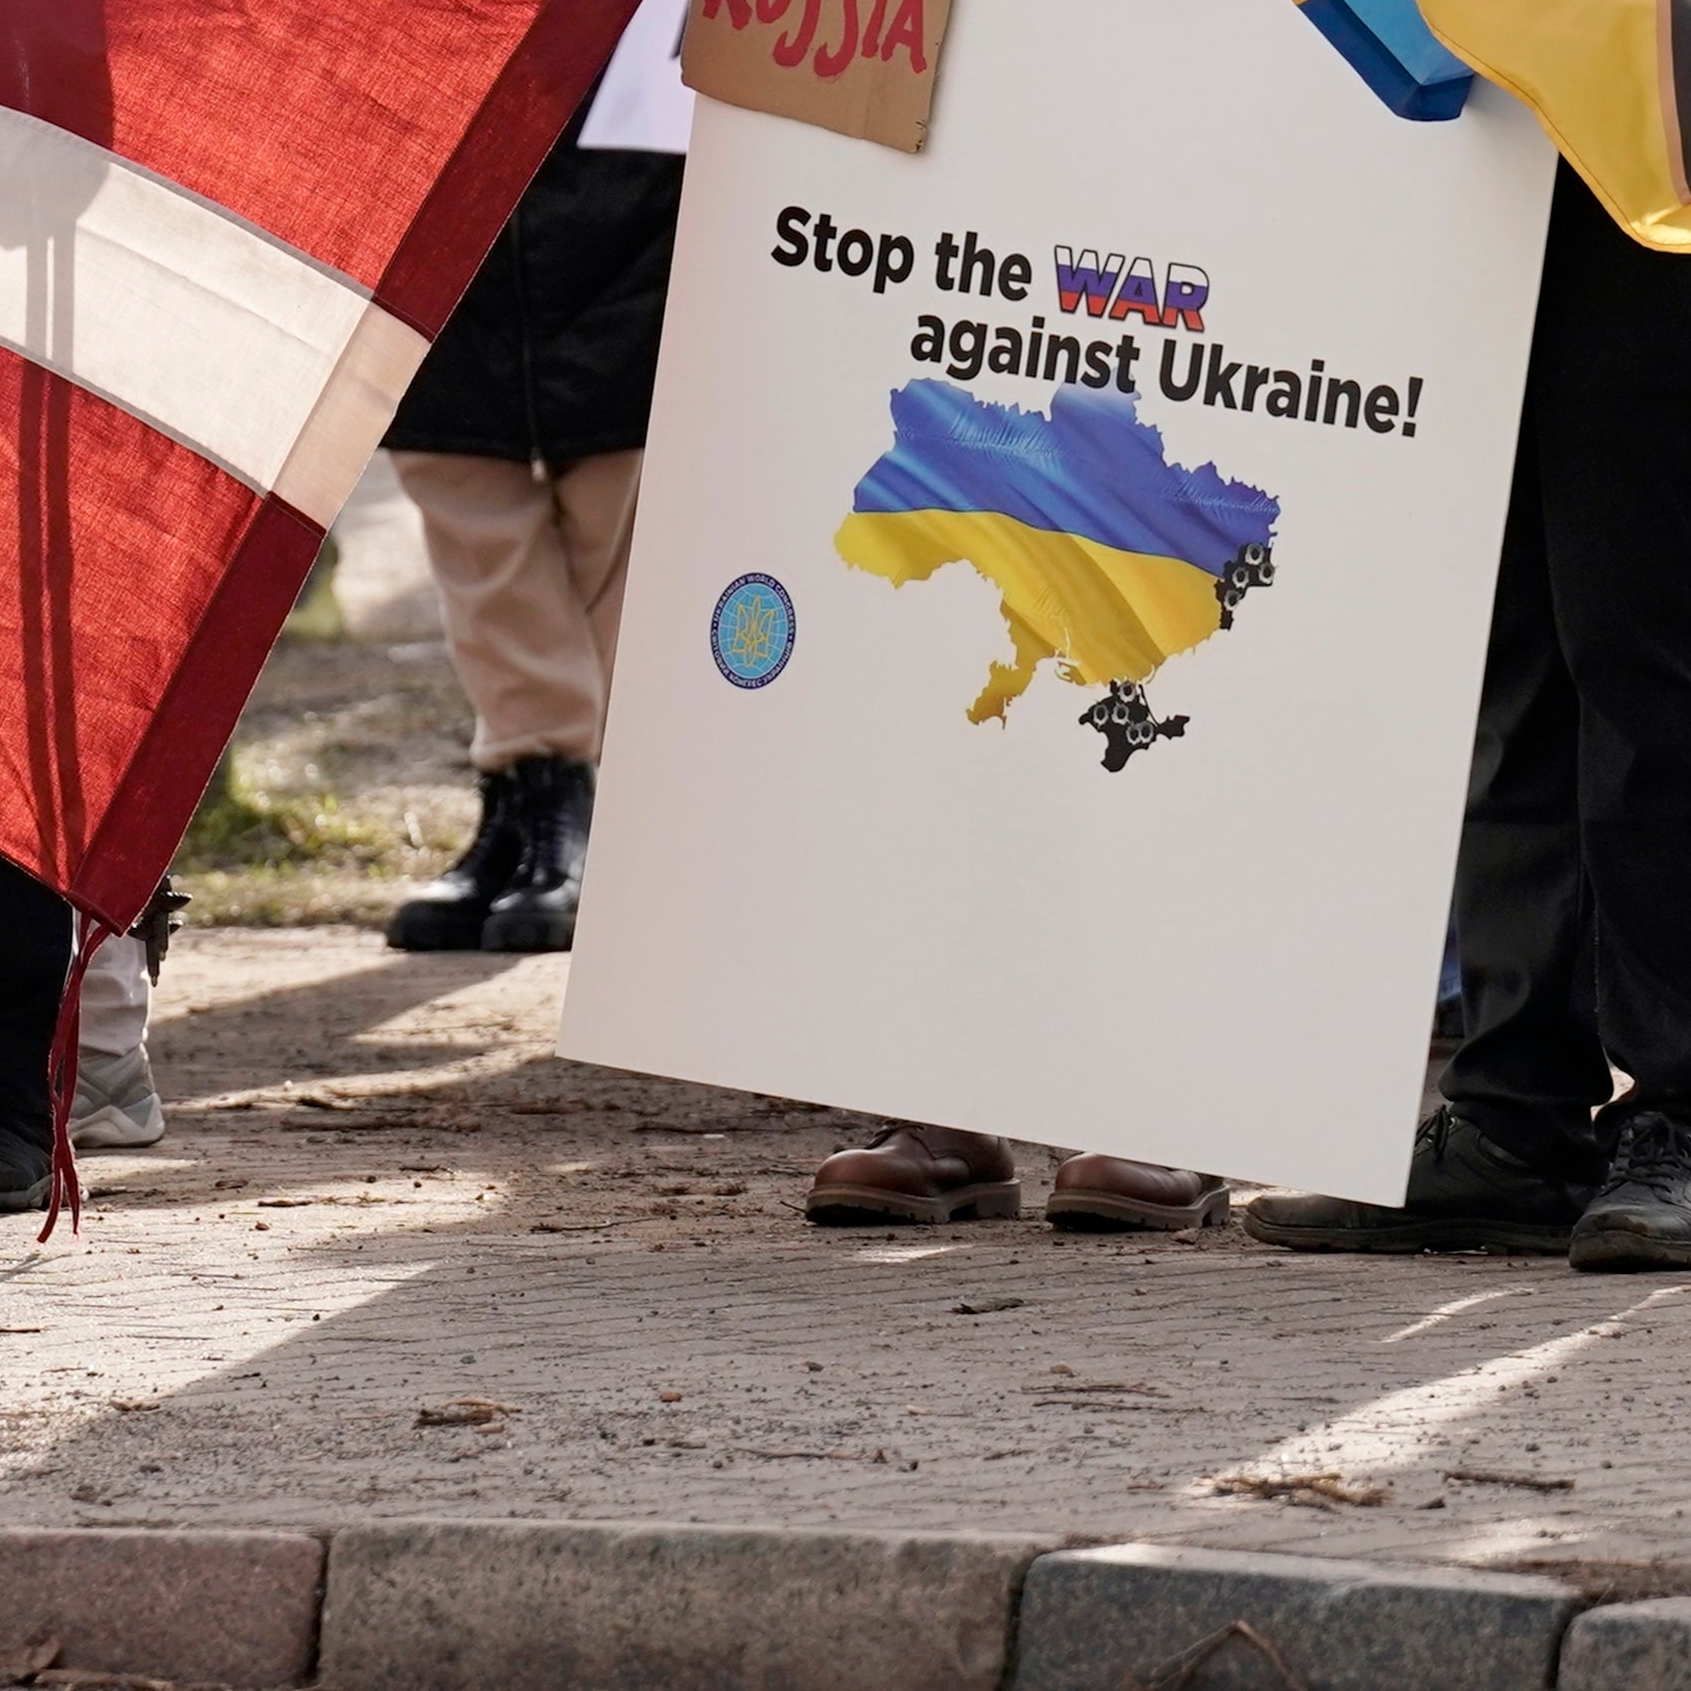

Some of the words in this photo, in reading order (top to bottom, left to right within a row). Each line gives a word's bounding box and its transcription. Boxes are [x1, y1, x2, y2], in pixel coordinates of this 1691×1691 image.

[770, 205, 915, 294] Stop
[935, 231, 1032, 303] the
[1054, 244, 1210, 333] WAR
[909, 313, 1140, 394] against
[1158, 338, 1424, 438] Ukraine!
